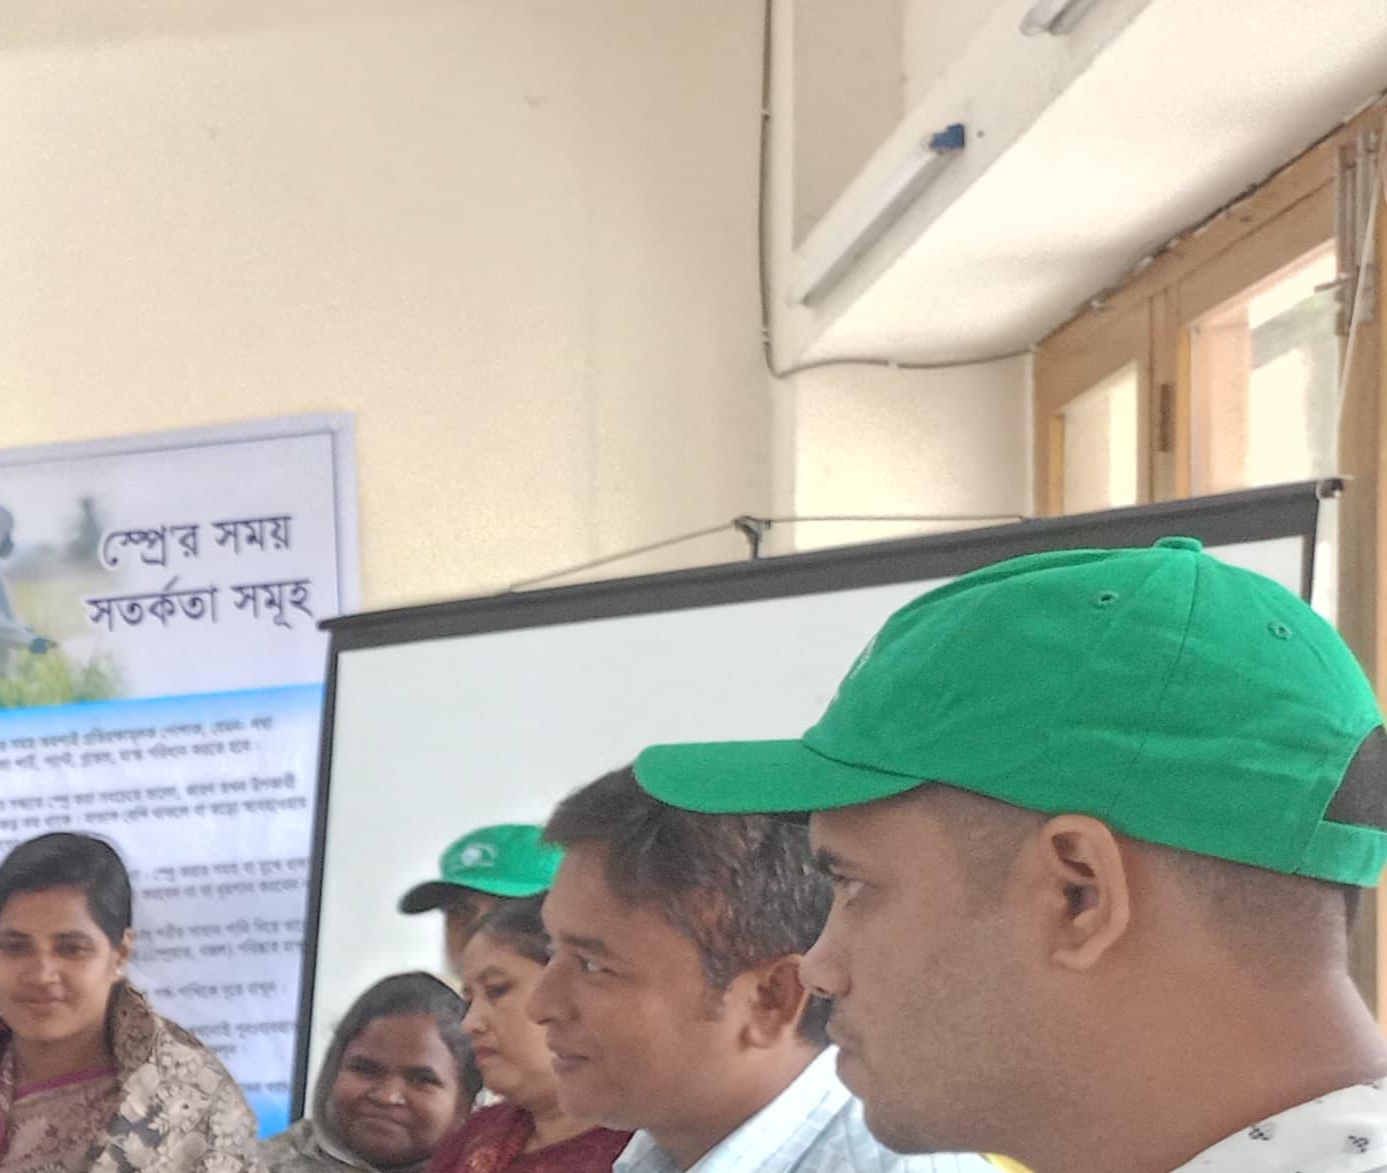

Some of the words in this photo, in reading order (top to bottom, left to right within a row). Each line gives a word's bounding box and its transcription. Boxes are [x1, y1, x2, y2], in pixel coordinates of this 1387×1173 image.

[212, 514, 292, 555] সময়
[86, 576, 218, 632] সতর্কতা
[231, 578, 314, 629] সমূহ
